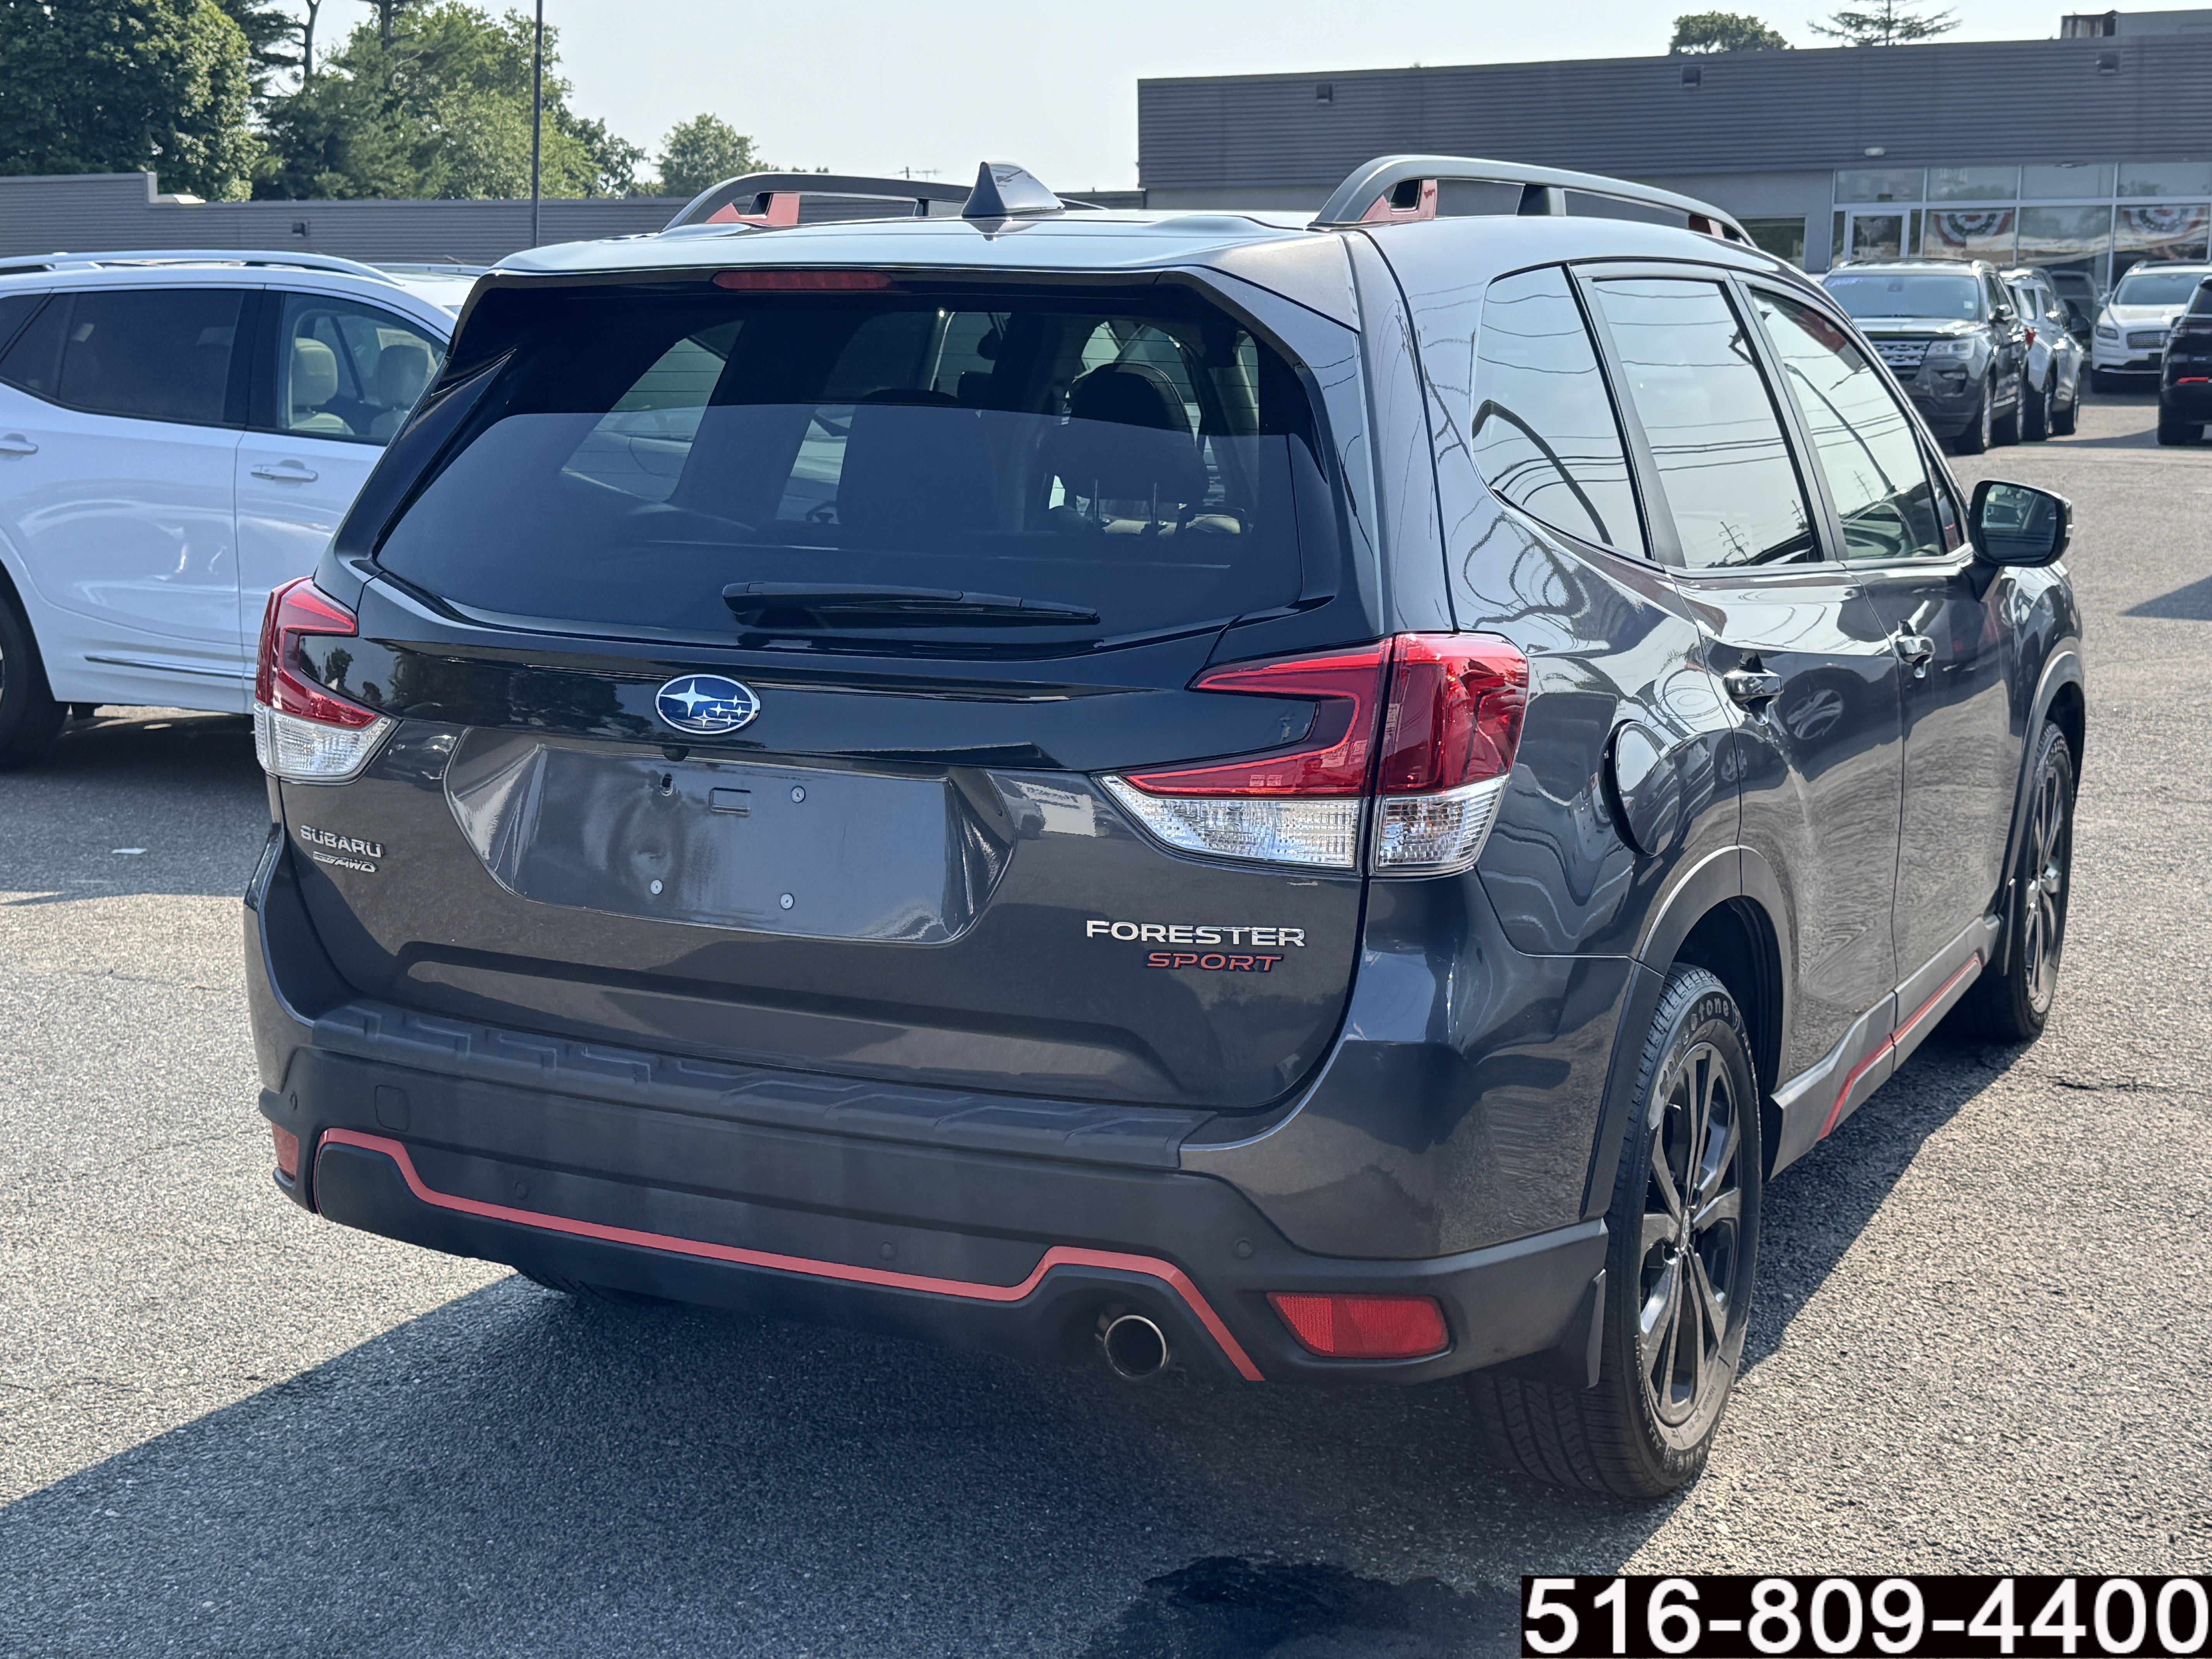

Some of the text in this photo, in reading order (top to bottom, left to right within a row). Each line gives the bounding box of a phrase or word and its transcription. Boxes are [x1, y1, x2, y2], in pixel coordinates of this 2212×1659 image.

[300, 825, 383, 858] SUBARU
[1086, 920, 1305, 946] FORESTER
[1147, 952, 1282, 972] SPORT
